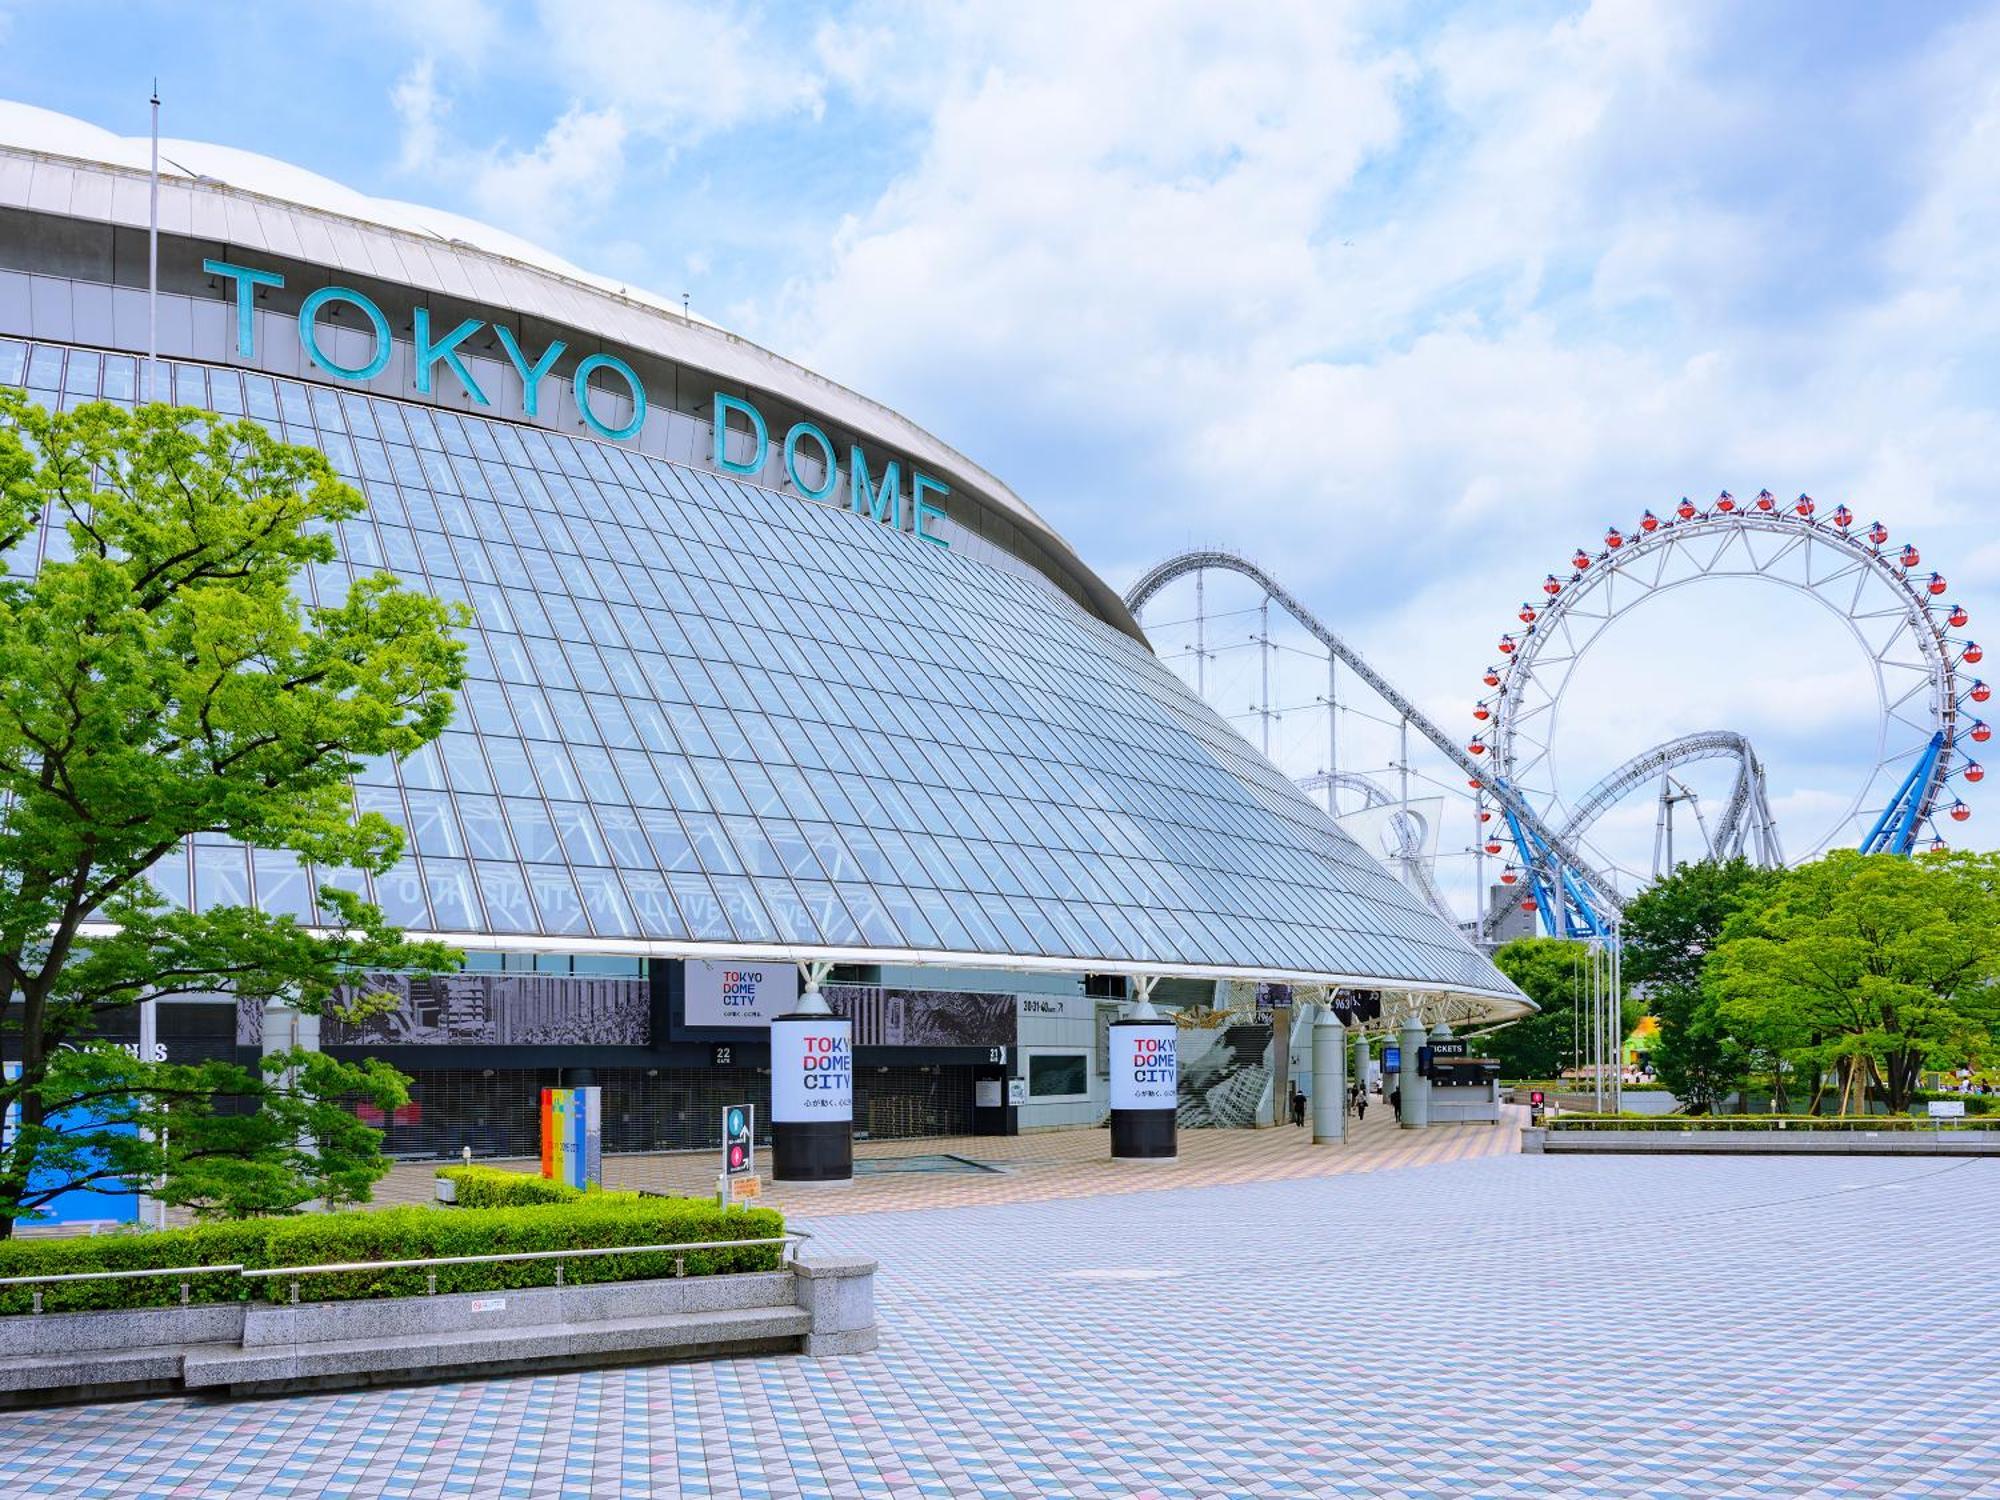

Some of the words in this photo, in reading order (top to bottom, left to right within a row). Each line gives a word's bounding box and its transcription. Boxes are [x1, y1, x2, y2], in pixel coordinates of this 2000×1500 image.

[203, 257, 647, 440] TOKYO
[713, 391, 951, 549] DOME
[722, 971, 762, 983] TOKYO
[722, 983, 755, 994] DOME
[722, 995, 755, 1006] CITY
[803, 1036, 850, 1053] TOKY
[716, 1047, 731, 1058] 22
[803, 1055, 850, 1071] DOME
[1134, 1055, 1175, 1067] DOME
[803, 1074, 850, 1090] CITY
[1134, 1070, 1174, 1083] CITY
